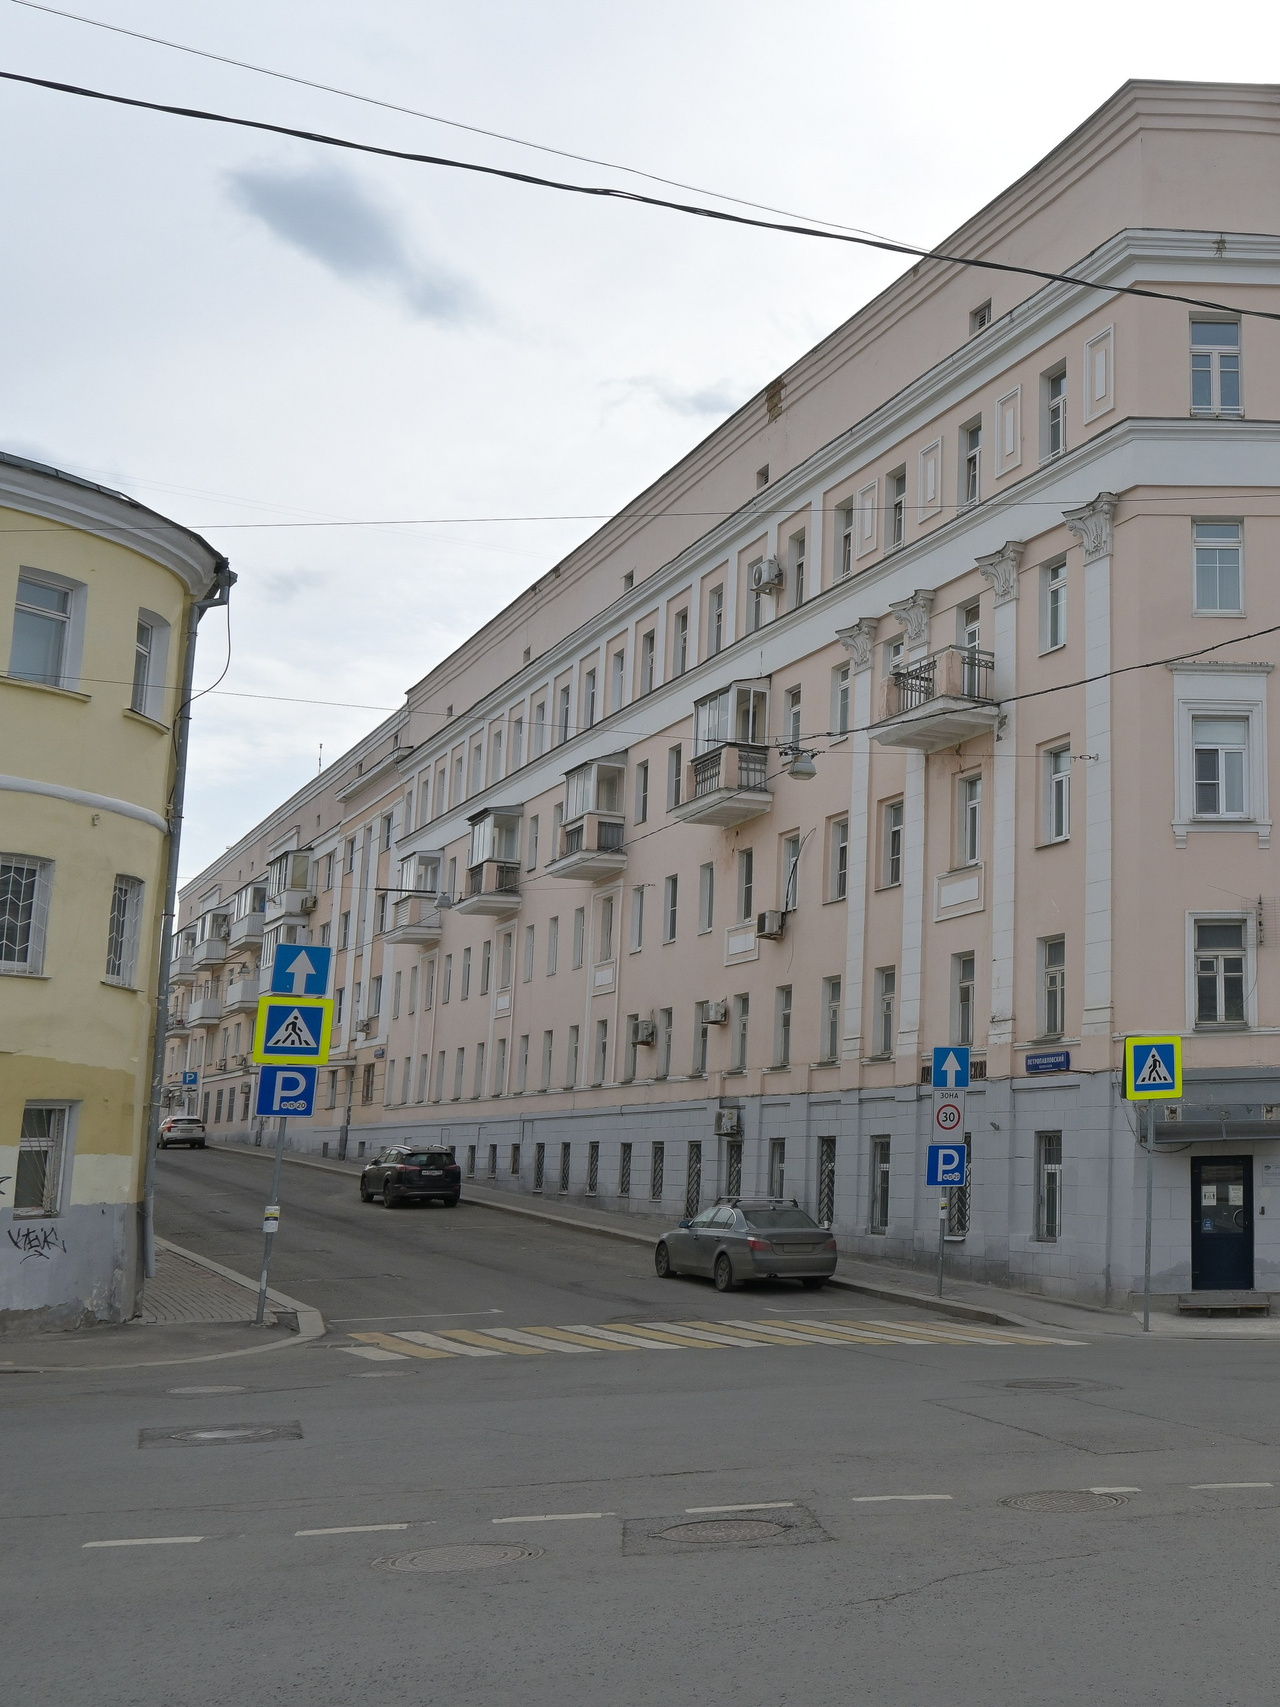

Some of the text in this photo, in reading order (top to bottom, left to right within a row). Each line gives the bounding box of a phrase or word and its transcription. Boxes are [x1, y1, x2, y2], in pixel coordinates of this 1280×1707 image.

[272, 1071, 306, 1110] P
[941, 1111, 956, 1123] 30
[937, 1149, 960, 1181] P
